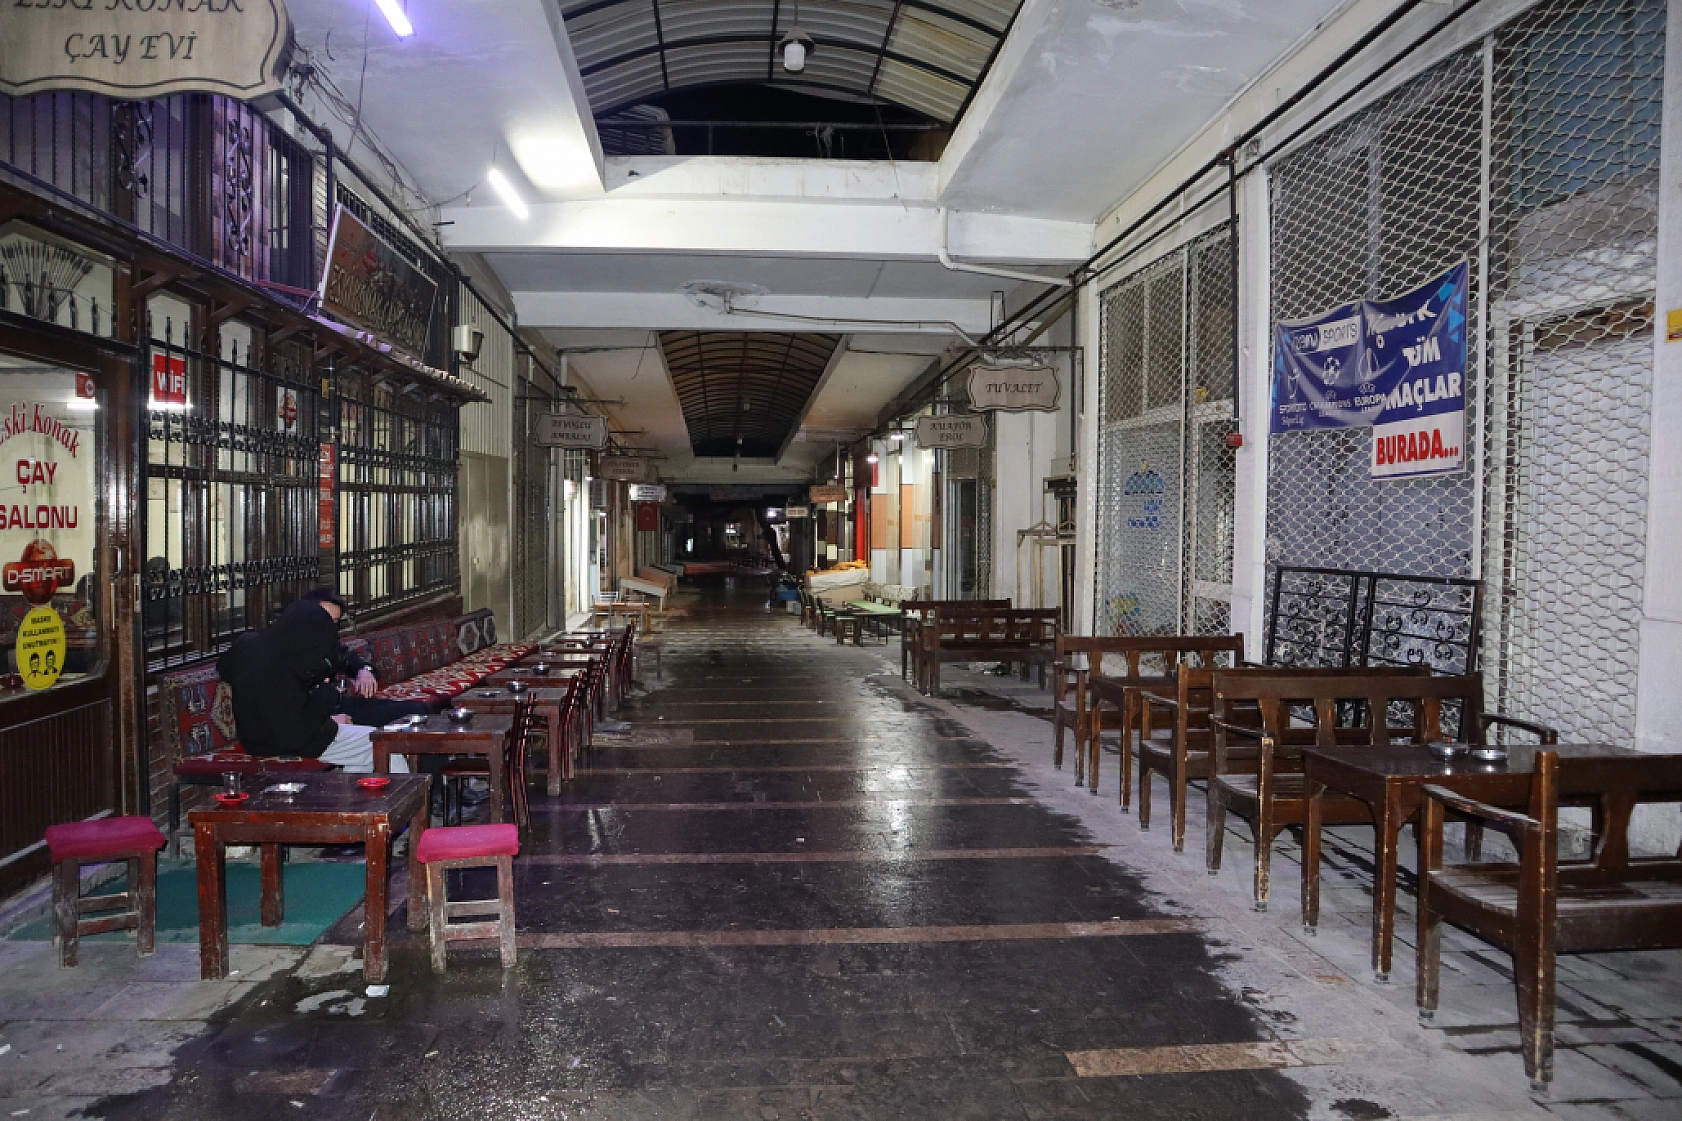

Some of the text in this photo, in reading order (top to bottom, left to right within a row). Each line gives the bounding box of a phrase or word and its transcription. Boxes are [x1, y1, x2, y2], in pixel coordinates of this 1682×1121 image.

[65, 31, 197, 64] ÇAY EVİ
[985, 382, 1043, 393] TUVALET
[1385, 372, 1462, 411] MAÇLAR
[33, 403, 80, 458] Konak
[1375, 428, 1459, 466] BURADA...
[17, 459, 57, 494] ÇAY
